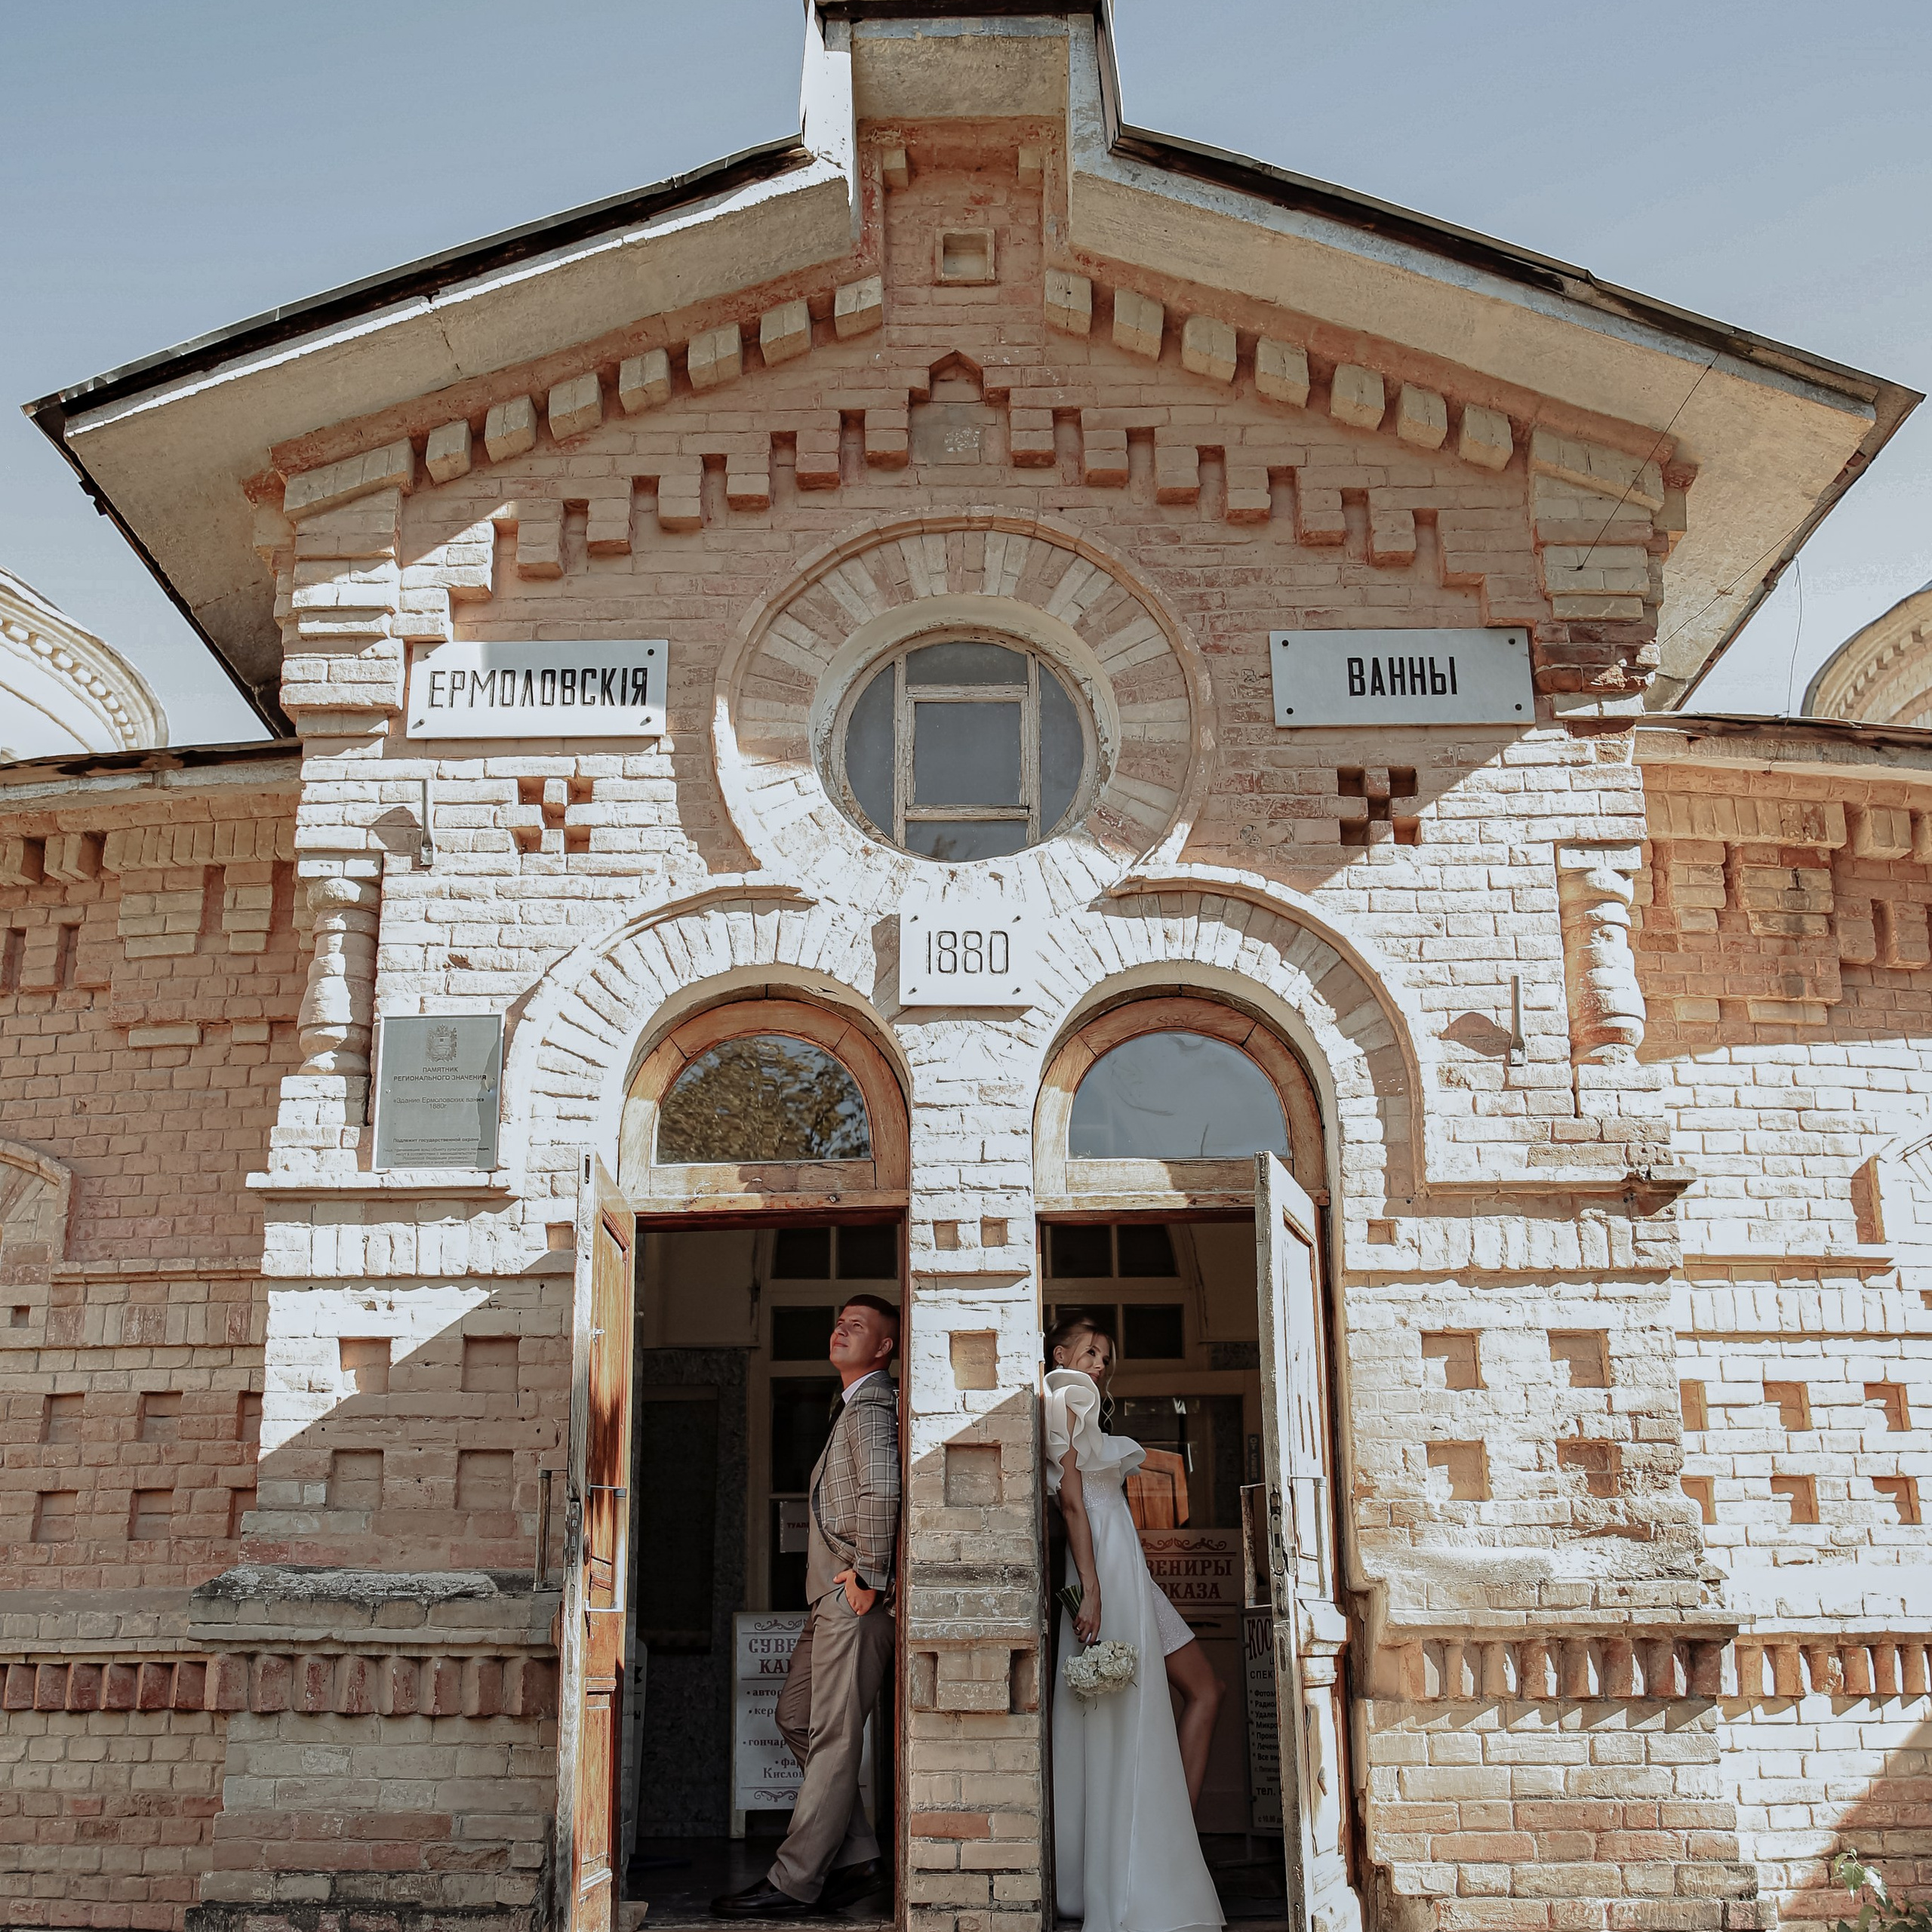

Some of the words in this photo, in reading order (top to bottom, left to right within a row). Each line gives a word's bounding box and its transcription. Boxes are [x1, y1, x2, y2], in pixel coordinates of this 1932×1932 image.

[1347, 657, 1458, 697] ВАННЫ
[926, 931, 1009, 975] 1880
[1146, 1559, 1232, 1577] ВЕНИРЫ
[1160, 1583, 1222, 1599] КАЗА
[749, 1638, 798, 1654] СУВЕ
[1247, 1617, 1274, 1660] КОС
[752, 1690, 782, 1698] автор
[755, 1708, 776, 1717] кер
[1256, 1721, 1278, 1730] Микро
[748, 1739, 786, 1748] гончар
